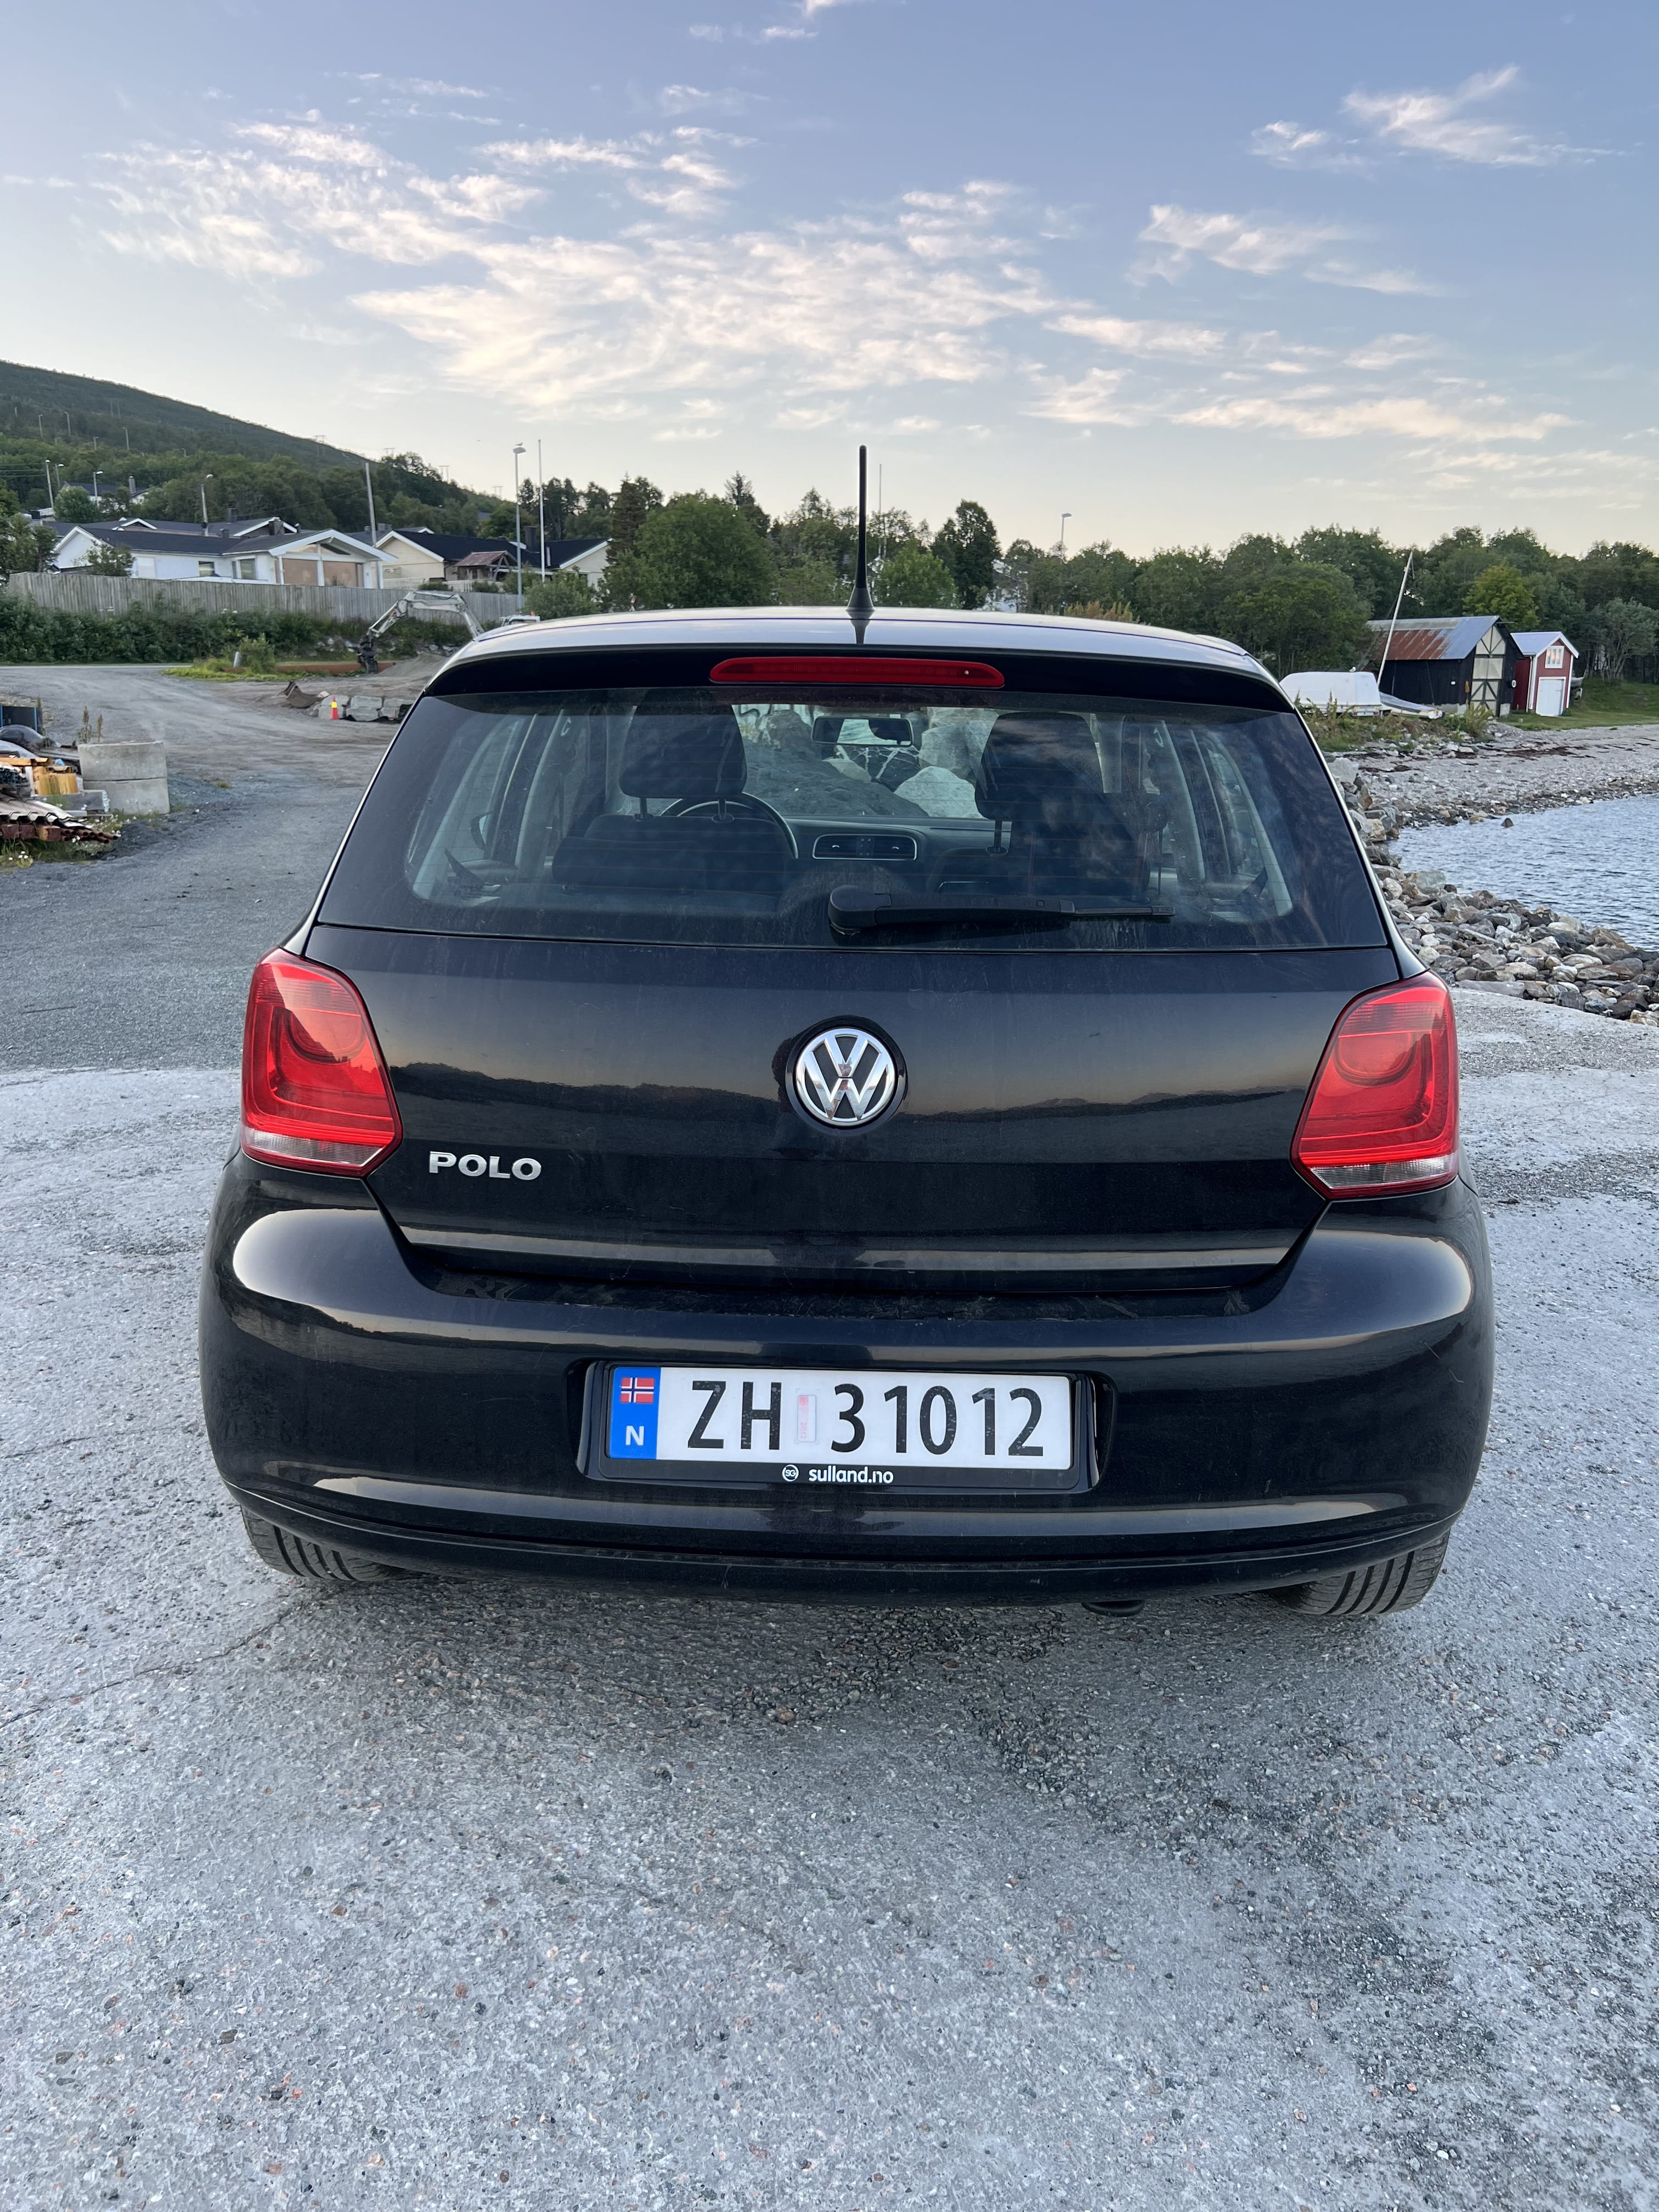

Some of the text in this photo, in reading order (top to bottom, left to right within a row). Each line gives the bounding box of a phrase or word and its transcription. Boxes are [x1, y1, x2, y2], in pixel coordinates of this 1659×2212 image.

[429, 1151, 542, 1180] POLO
[687, 1380, 1044, 1457] ZH 31012
[625, 1425, 645, 1446] N
[809, 1465, 894, 1484] sulland.no
